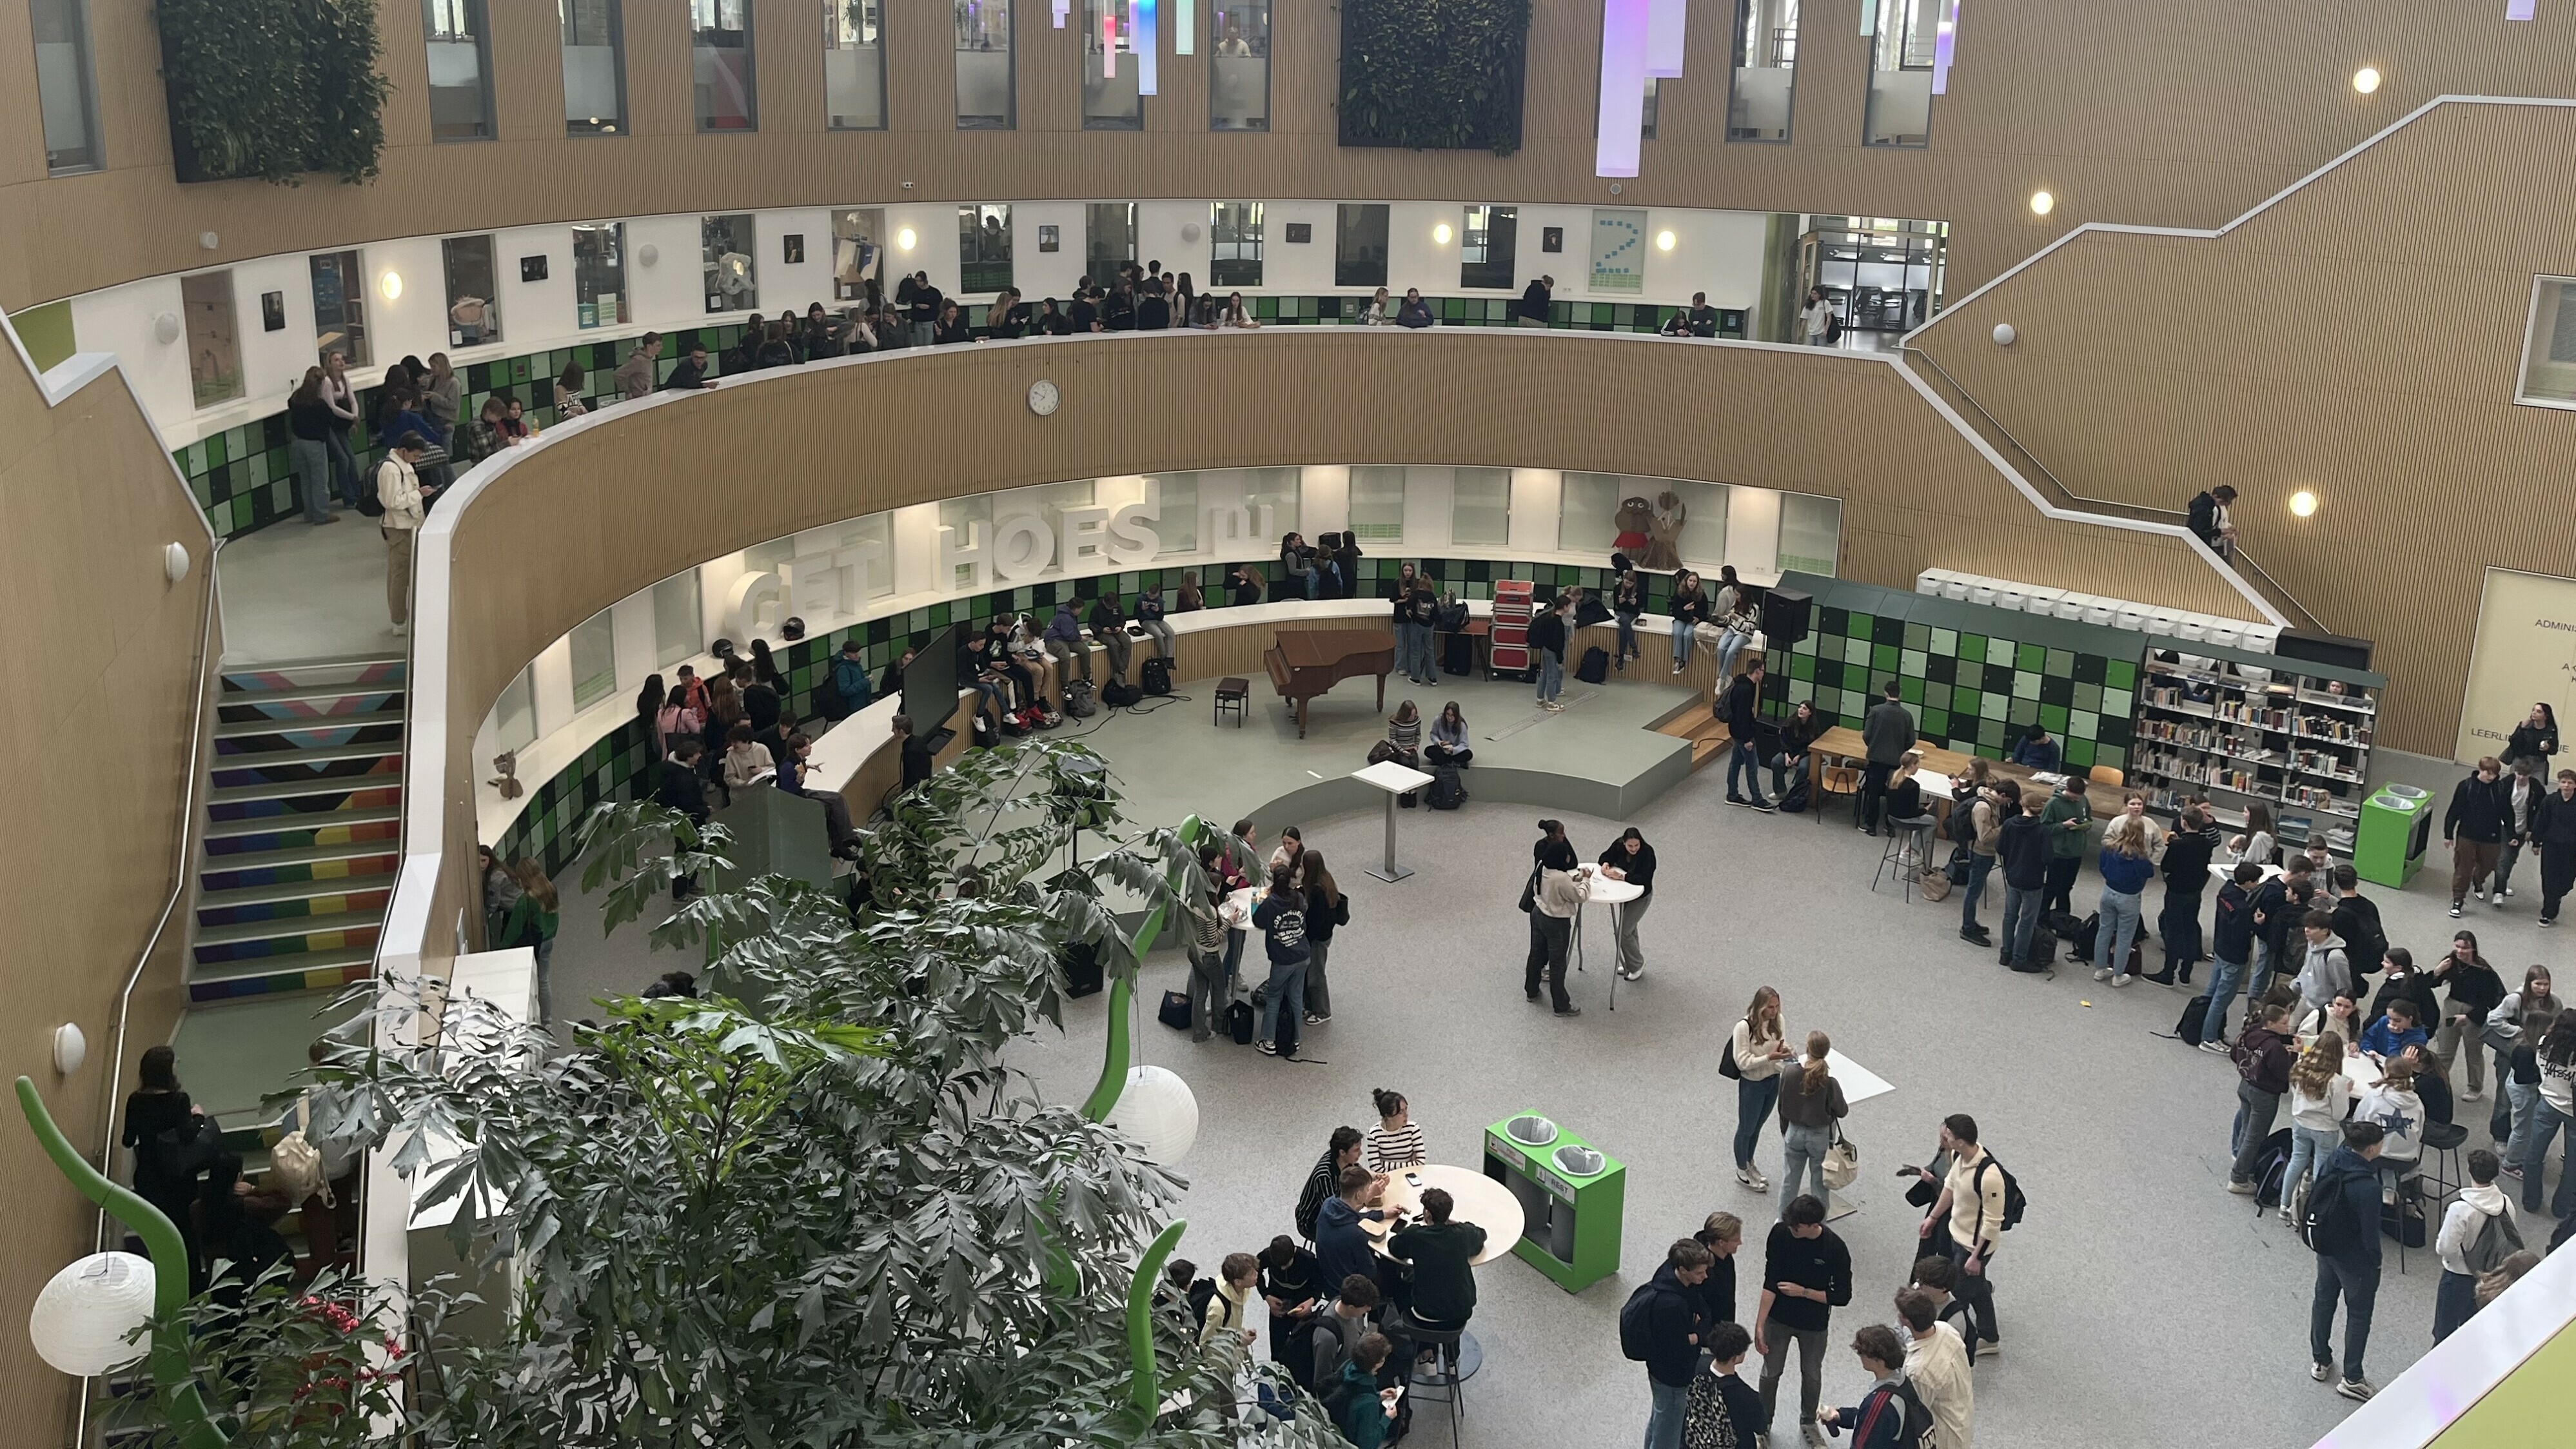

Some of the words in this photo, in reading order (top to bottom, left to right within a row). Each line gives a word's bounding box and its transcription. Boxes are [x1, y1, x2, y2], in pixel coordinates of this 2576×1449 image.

[2535, 619, 2576, 633] ADMINI
[2379, 1117, 2414, 1130] LUCKY
[1551, 1178, 1568, 1193] REST
